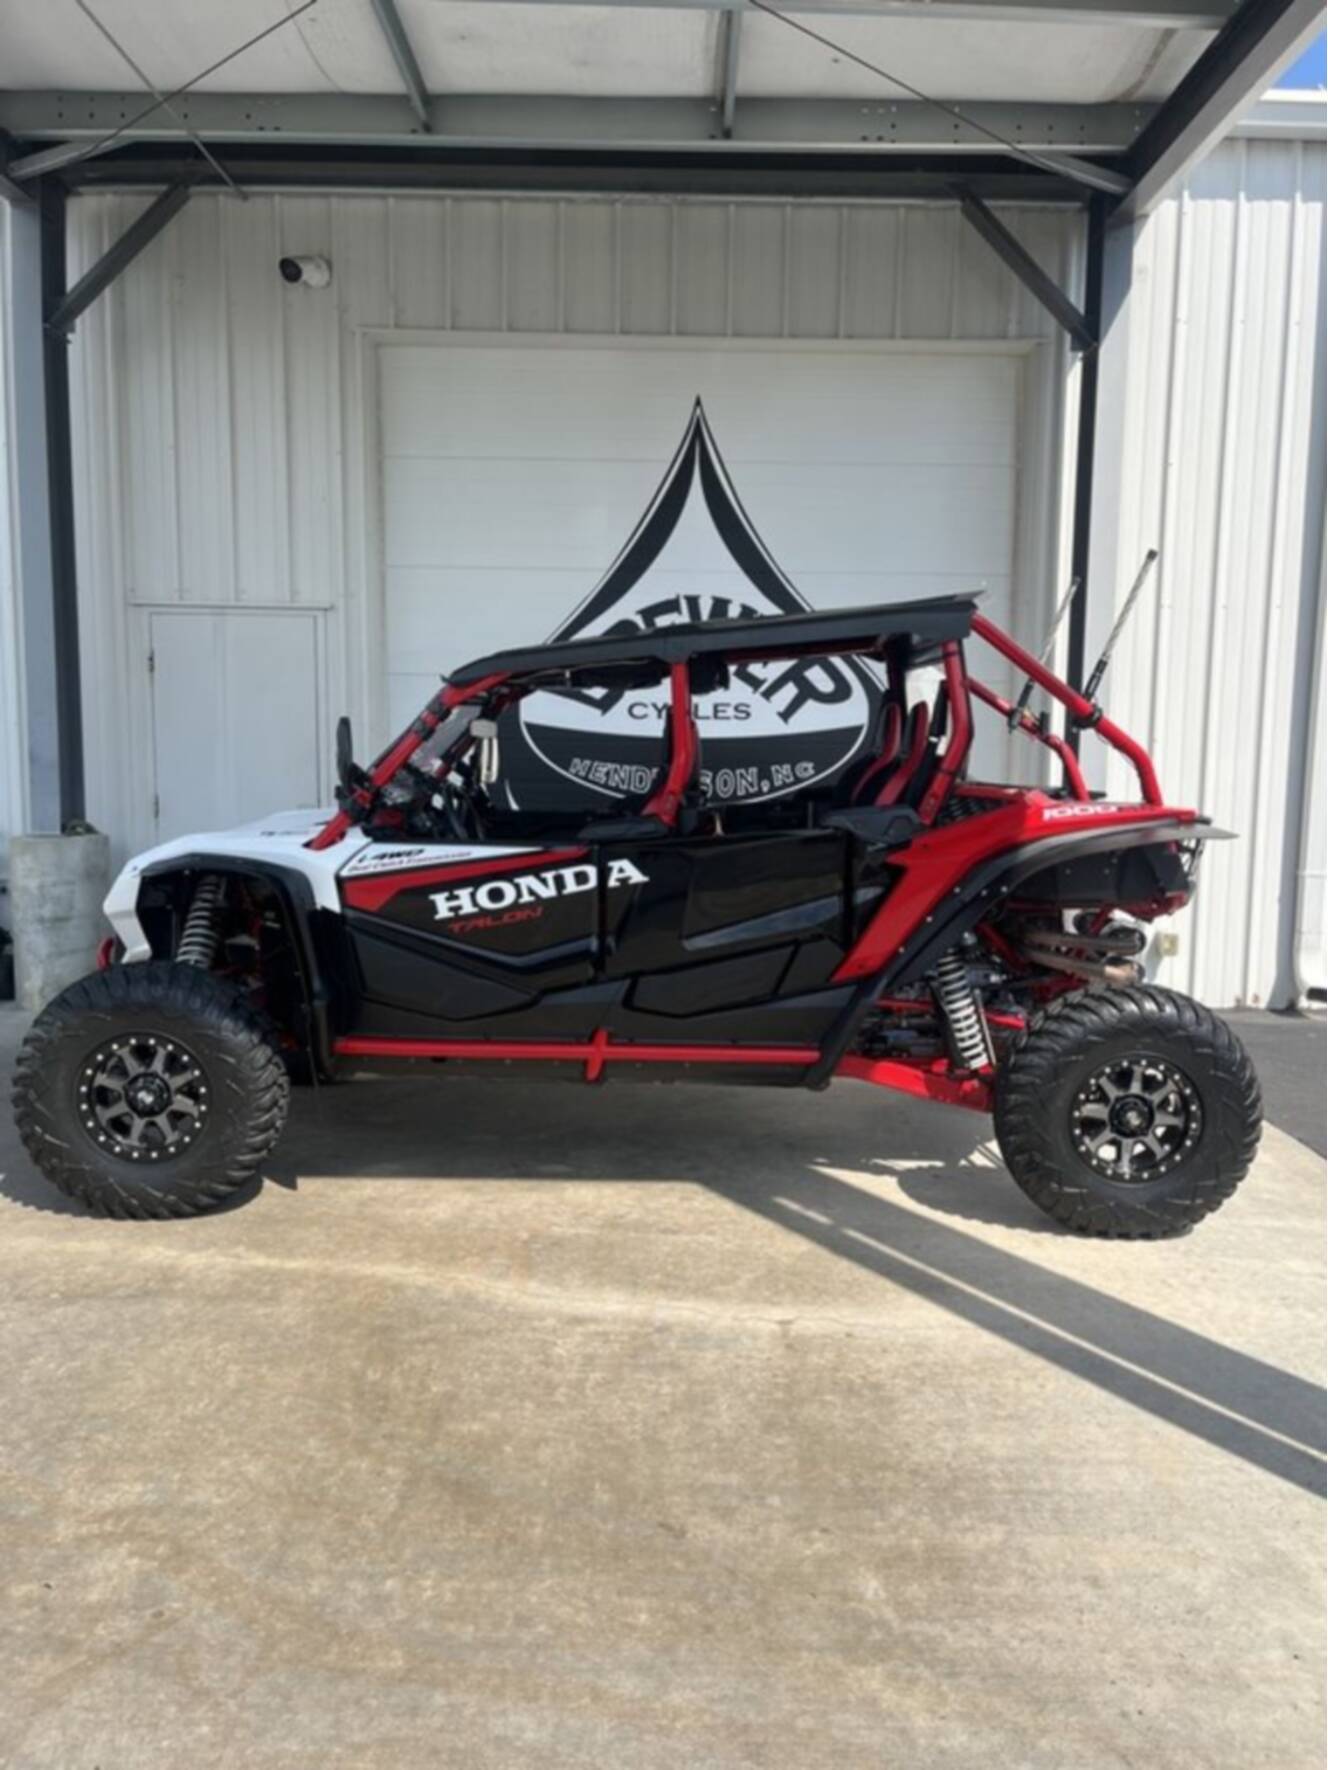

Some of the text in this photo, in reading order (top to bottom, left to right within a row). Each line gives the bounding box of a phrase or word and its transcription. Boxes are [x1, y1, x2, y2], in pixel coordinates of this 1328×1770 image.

[627, 702, 752, 721] CYLES
[429, 859, 649, 919] HONDA
[449, 906, 543, 933] TALON
